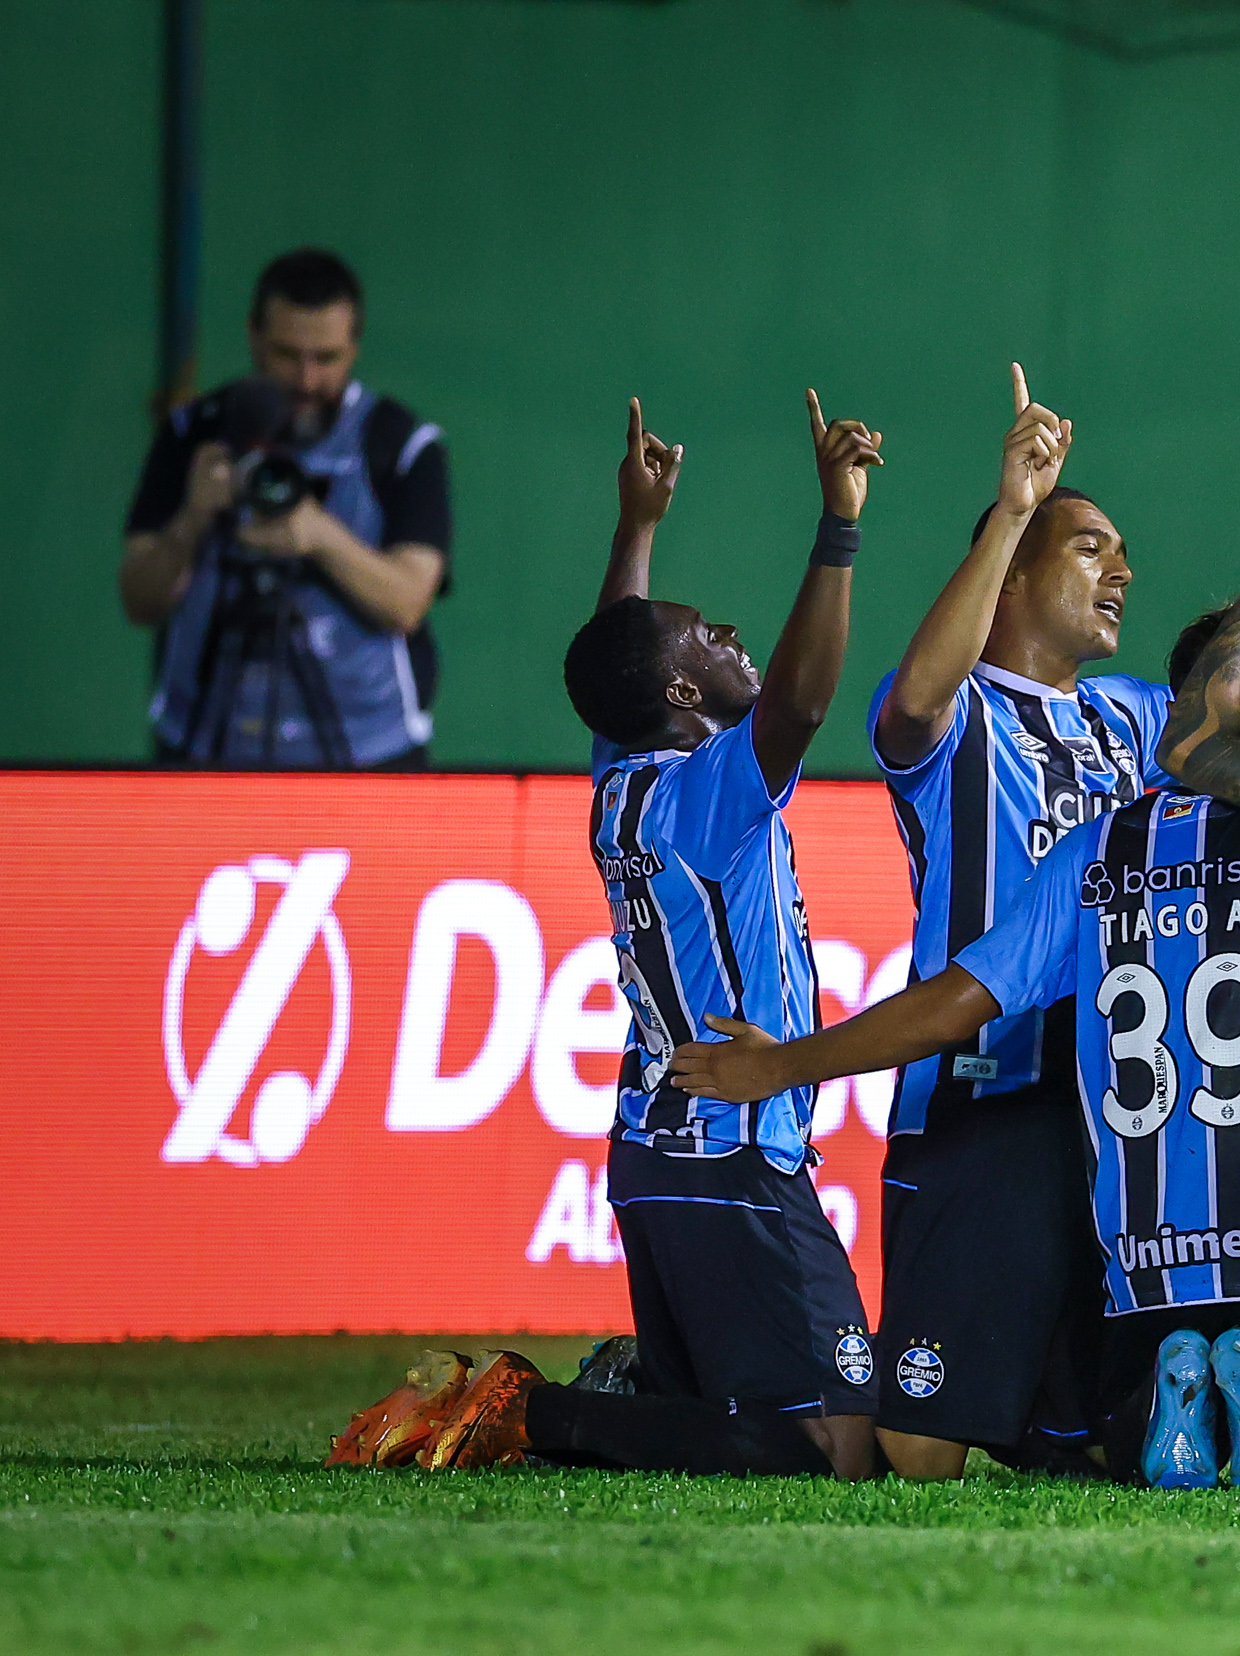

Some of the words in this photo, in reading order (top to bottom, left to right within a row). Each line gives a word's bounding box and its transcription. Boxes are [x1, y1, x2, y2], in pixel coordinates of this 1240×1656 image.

[1020, 748, 1049, 763] umbro
[1100, 902, 1208, 946] TIAGO
[1154, 1047, 1167, 1113] MARQUESPAN
